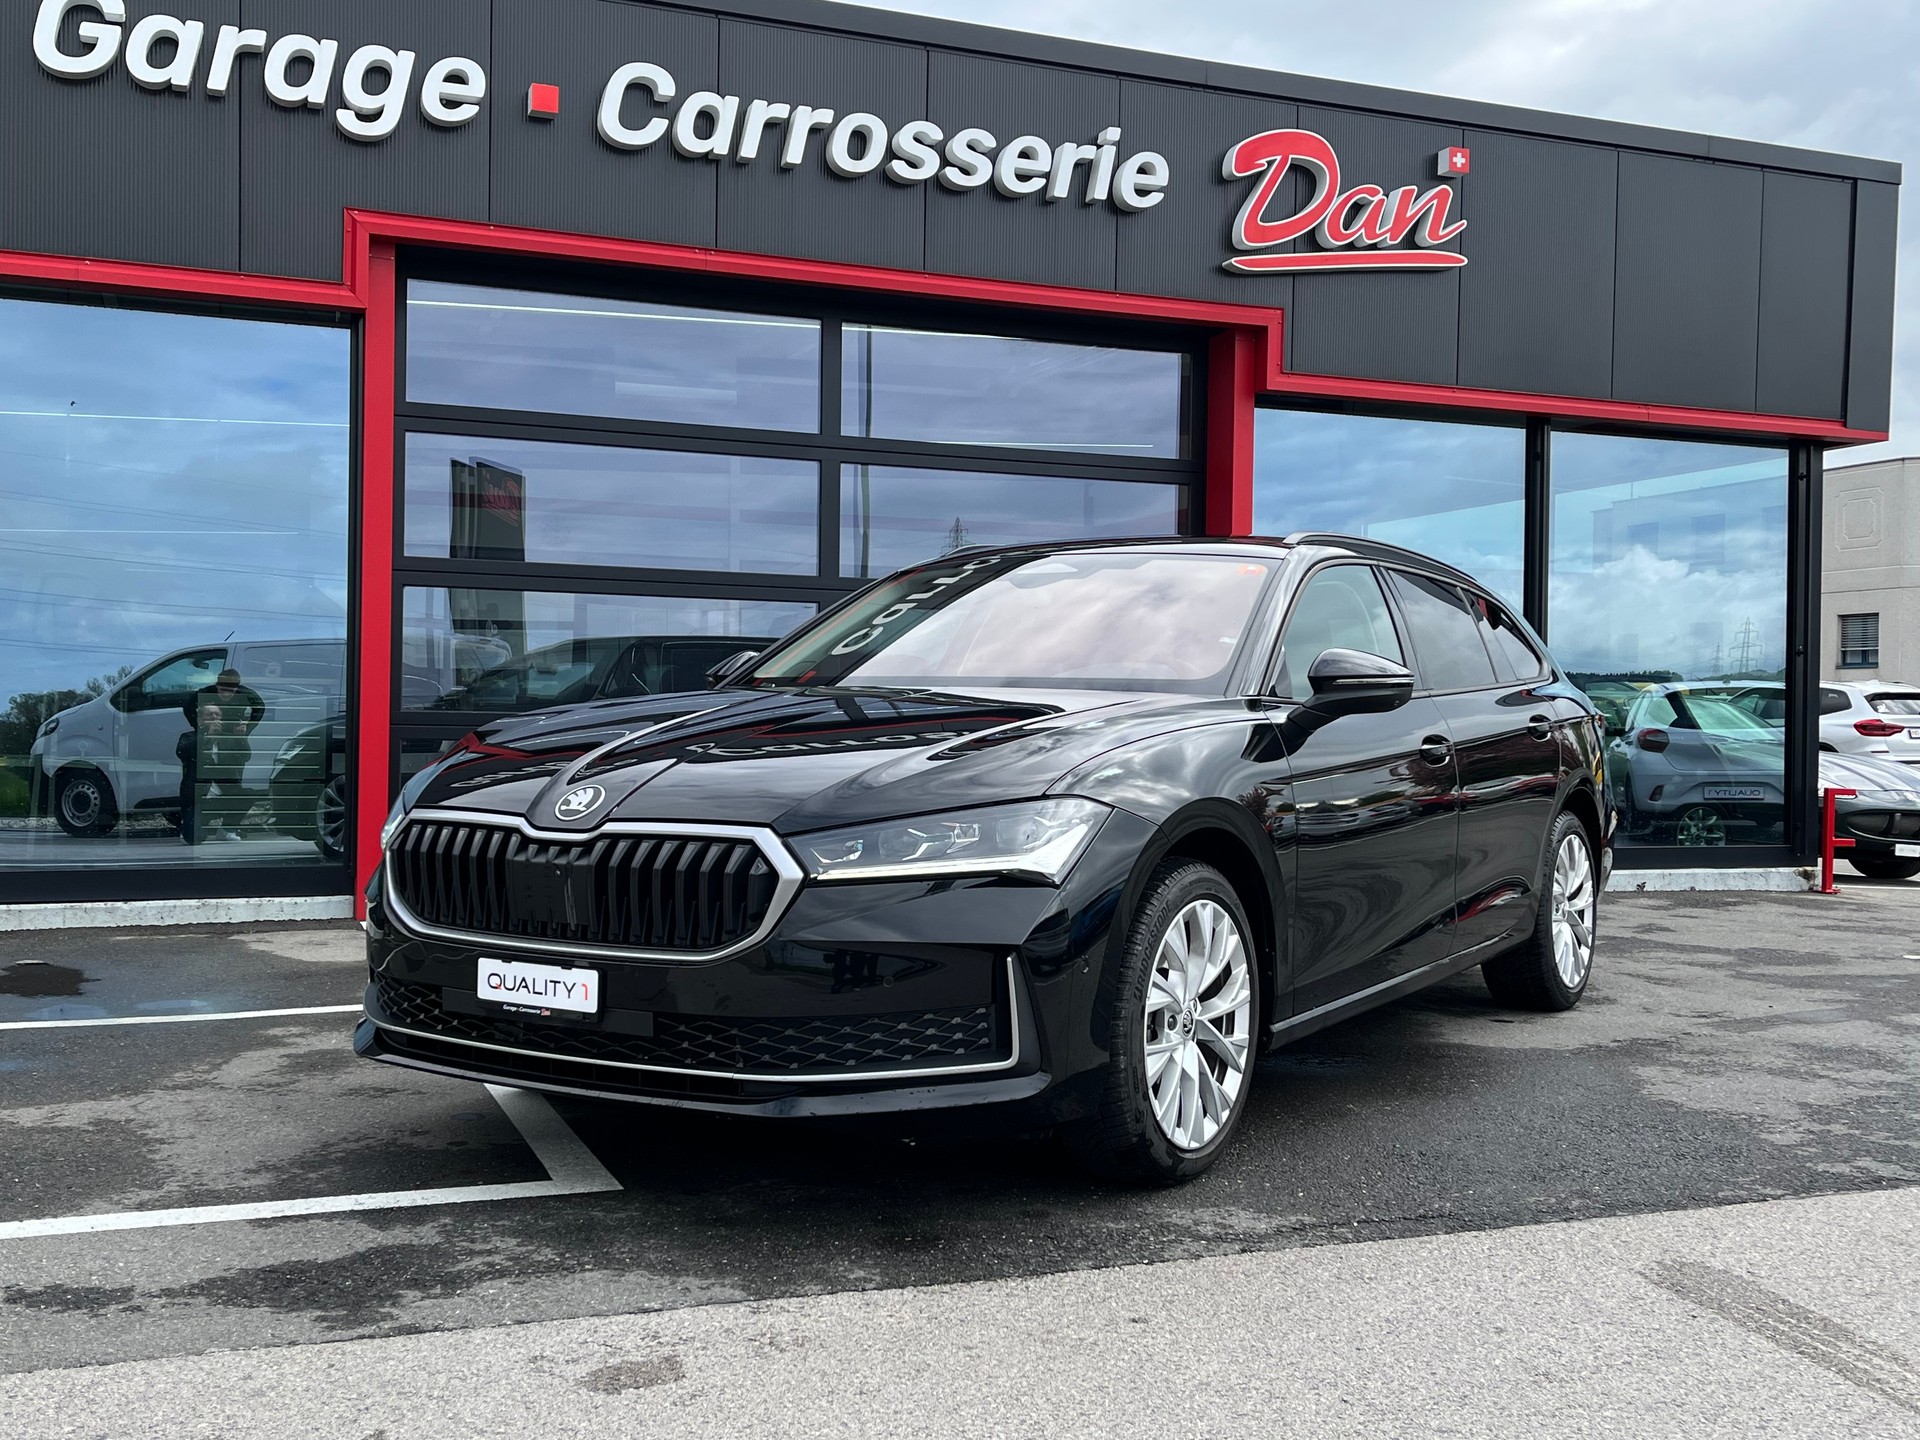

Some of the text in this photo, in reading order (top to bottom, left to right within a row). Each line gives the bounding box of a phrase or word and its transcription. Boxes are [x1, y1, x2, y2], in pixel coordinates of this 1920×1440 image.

[32, 0, 1468, 250] Garage Carrosserie Dan
[487, 972, 588, 1001] QUALITY 1
[1133, 899, 1172, 1001] BRIDGESTONE
